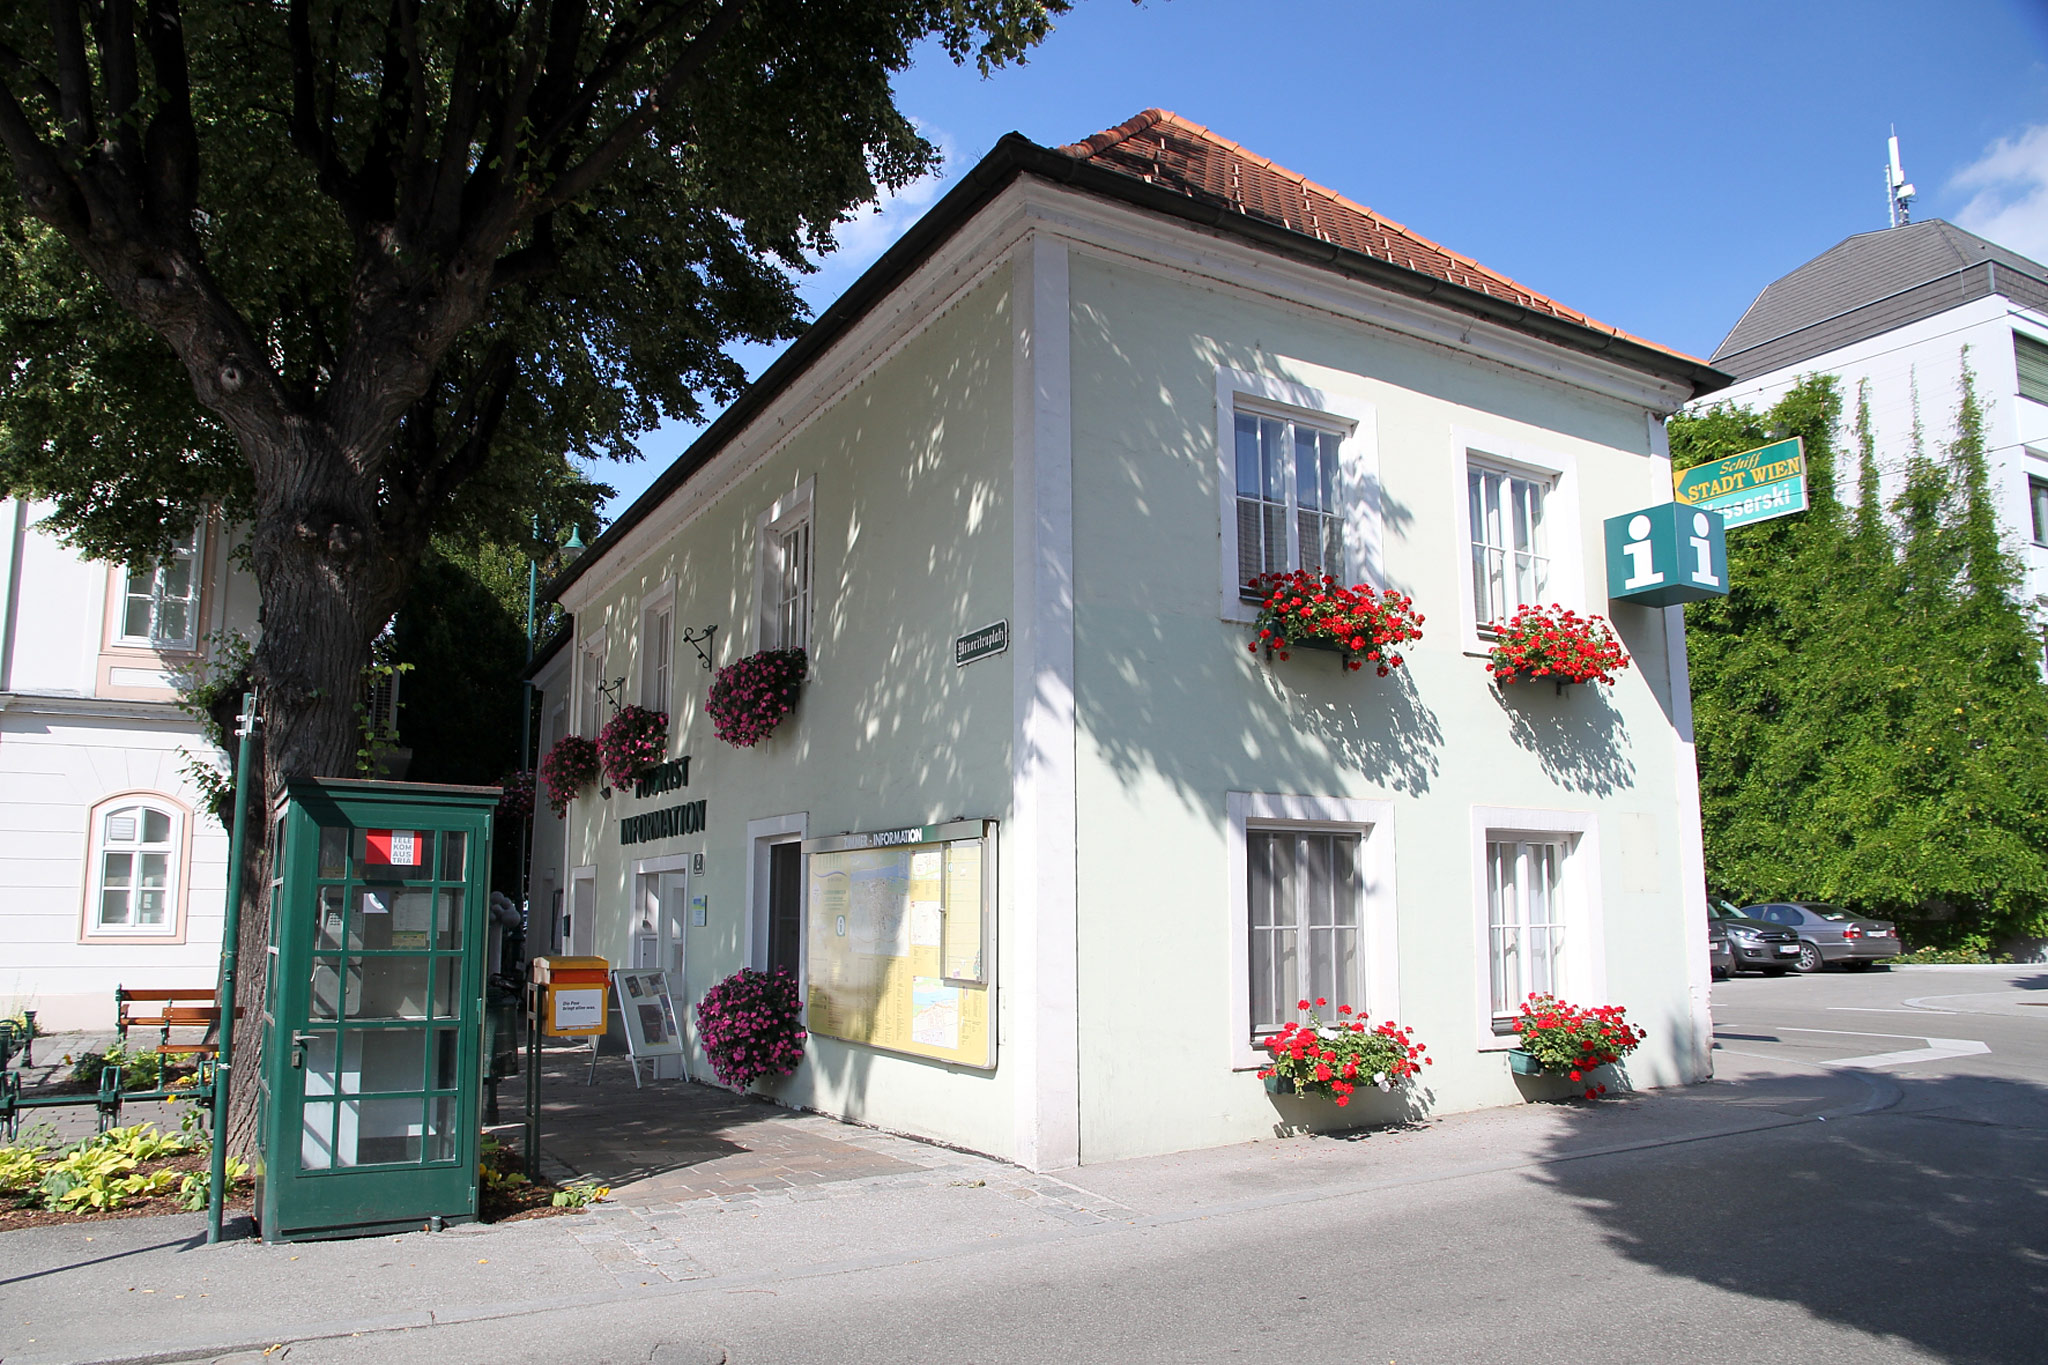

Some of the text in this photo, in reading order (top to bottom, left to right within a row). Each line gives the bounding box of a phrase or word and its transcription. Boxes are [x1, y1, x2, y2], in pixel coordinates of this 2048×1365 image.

[1687, 456, 1801, 502] STADT WIEN
[1720, 452, 1762, 475] Schiff
[1701, 483, 1791, 520] sserski
[958, 628, 1004, 656] Minoritenplatz
[620, 800, 707, 845] INFORMATION
[873, 828, 923, 846] INFORMATION
